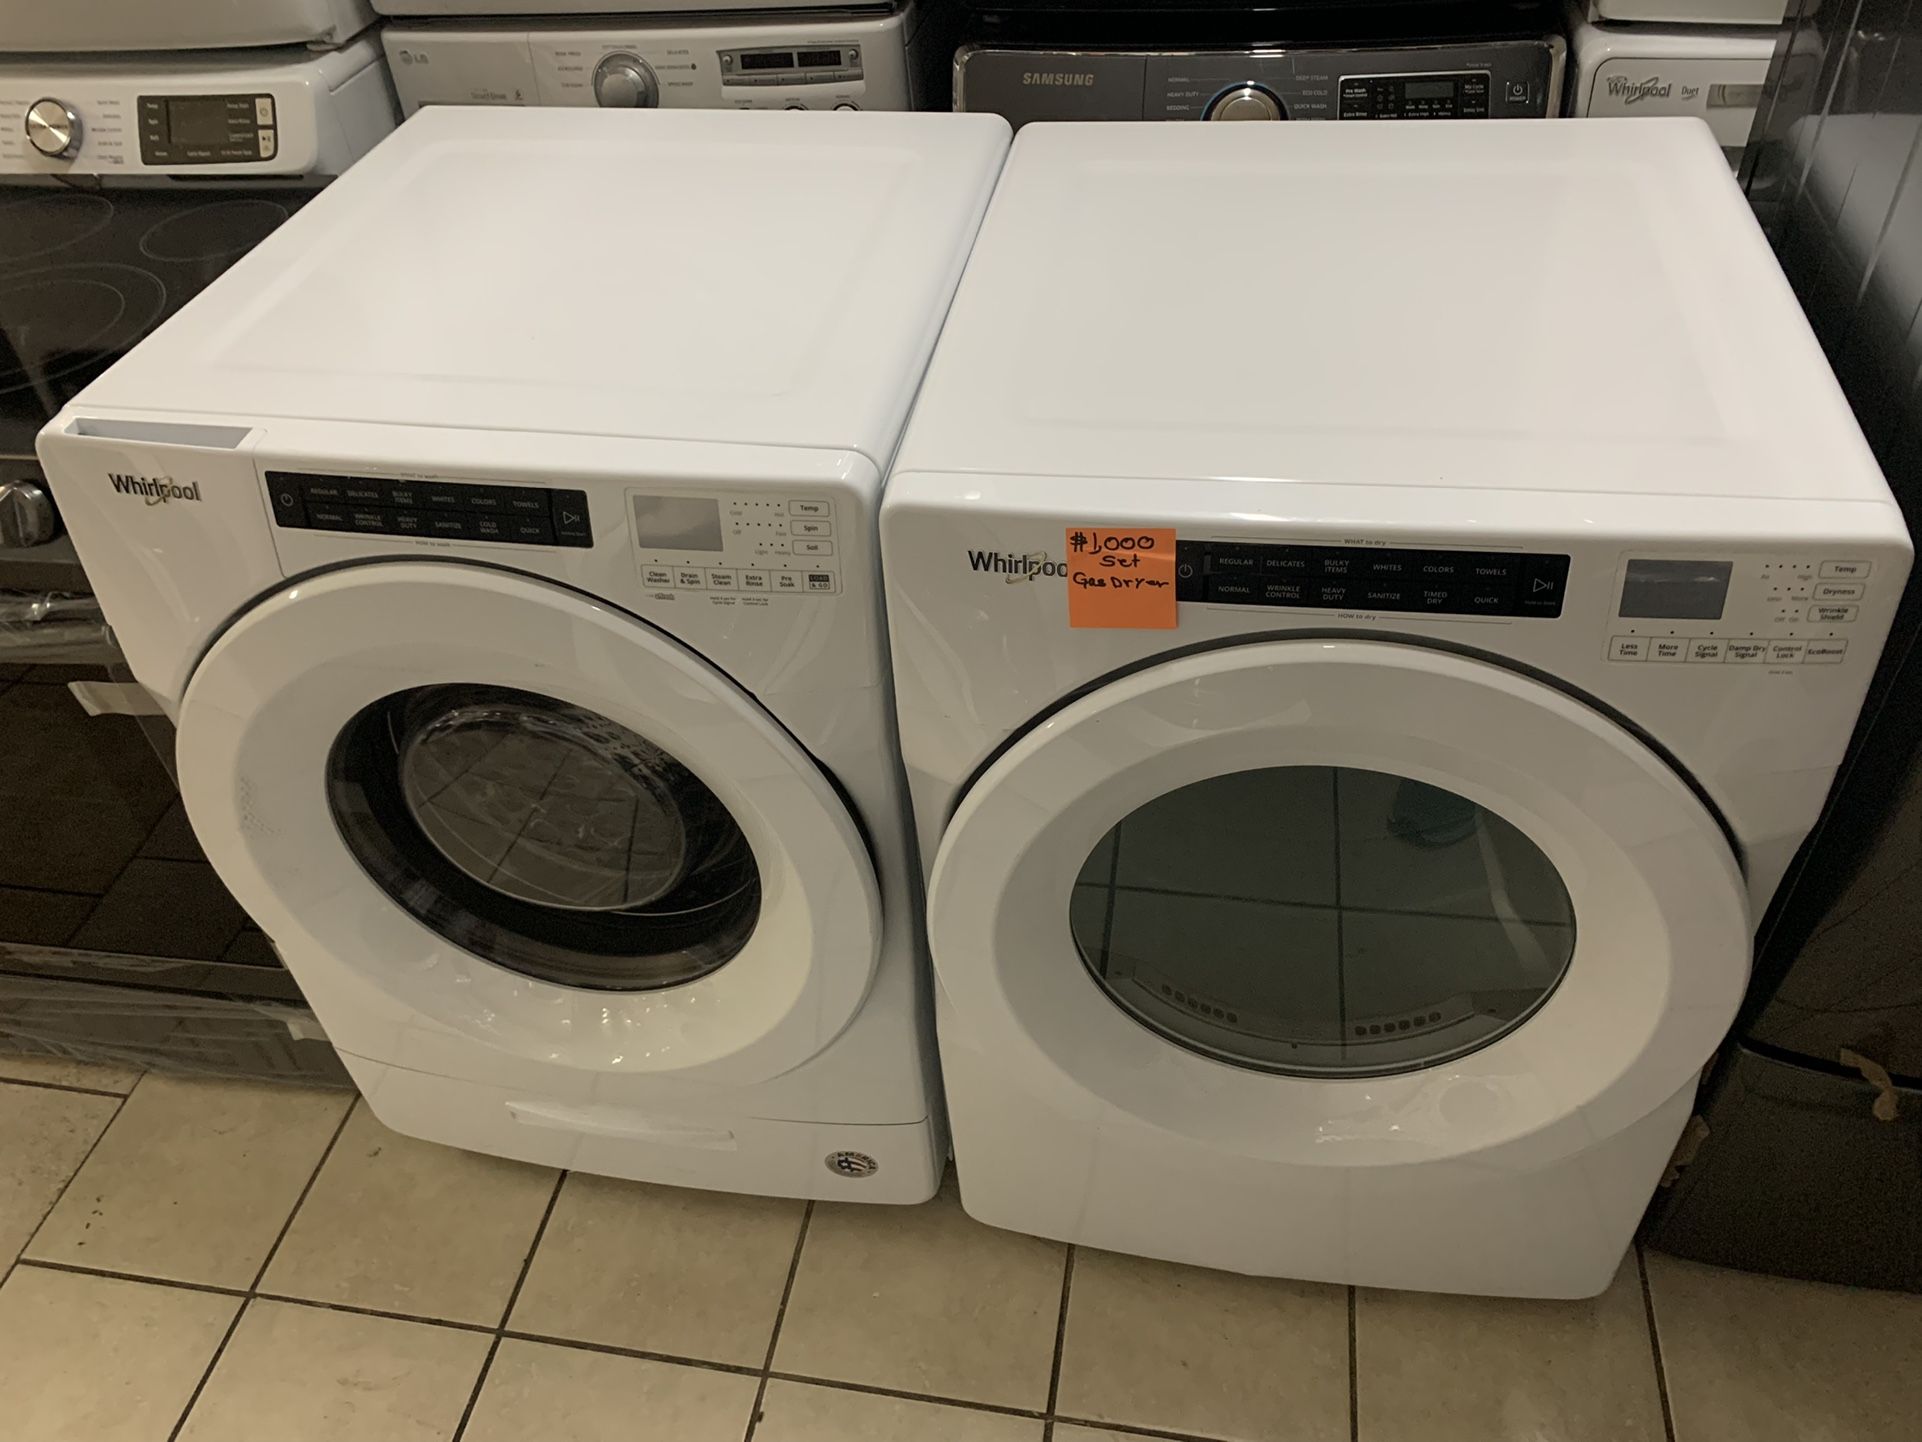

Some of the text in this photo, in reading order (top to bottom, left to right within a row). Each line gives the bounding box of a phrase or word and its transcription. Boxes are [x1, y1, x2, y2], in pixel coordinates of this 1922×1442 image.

[1023, 72, 1094, 86] SAMSUNG
[1606, 77, 1672, 104] Whirlpool
[108, 472, 202, 505] Whirlpool
[472, 498, 496, 506] COLORS
[513, 500, 539, 509] TOWELS
[800, 504, 820, 512] Temp
[520, 526, 540, 535] QUICK
[804, 524, 818, 532] Spin
[1099, 554, 1140, 568] Set
[1219, 558, 1254, 566] REGULAR
[1266, 560, 1305, 568] DELICATES
[1324, 559, 1350, 567] BULKY
[968, 551, 1068, 583] Whirlpoo
[1423, 566, 1454, 574] COLORS
[1834, 566, 1857, 574] Temp
[1476, 568, 1507, 576] TOWELS
[1073, 572, 1169, 589] Gas Dryer
[1218, 586, 1250, 594] NORMAL
[1823, 588, 1856, 596] Dryness
[1368, 592, 1400, 600] SANITIZE
[1474, 596, 1499, 604] QUICK
[1735, 651, 1758, 659] Signal
